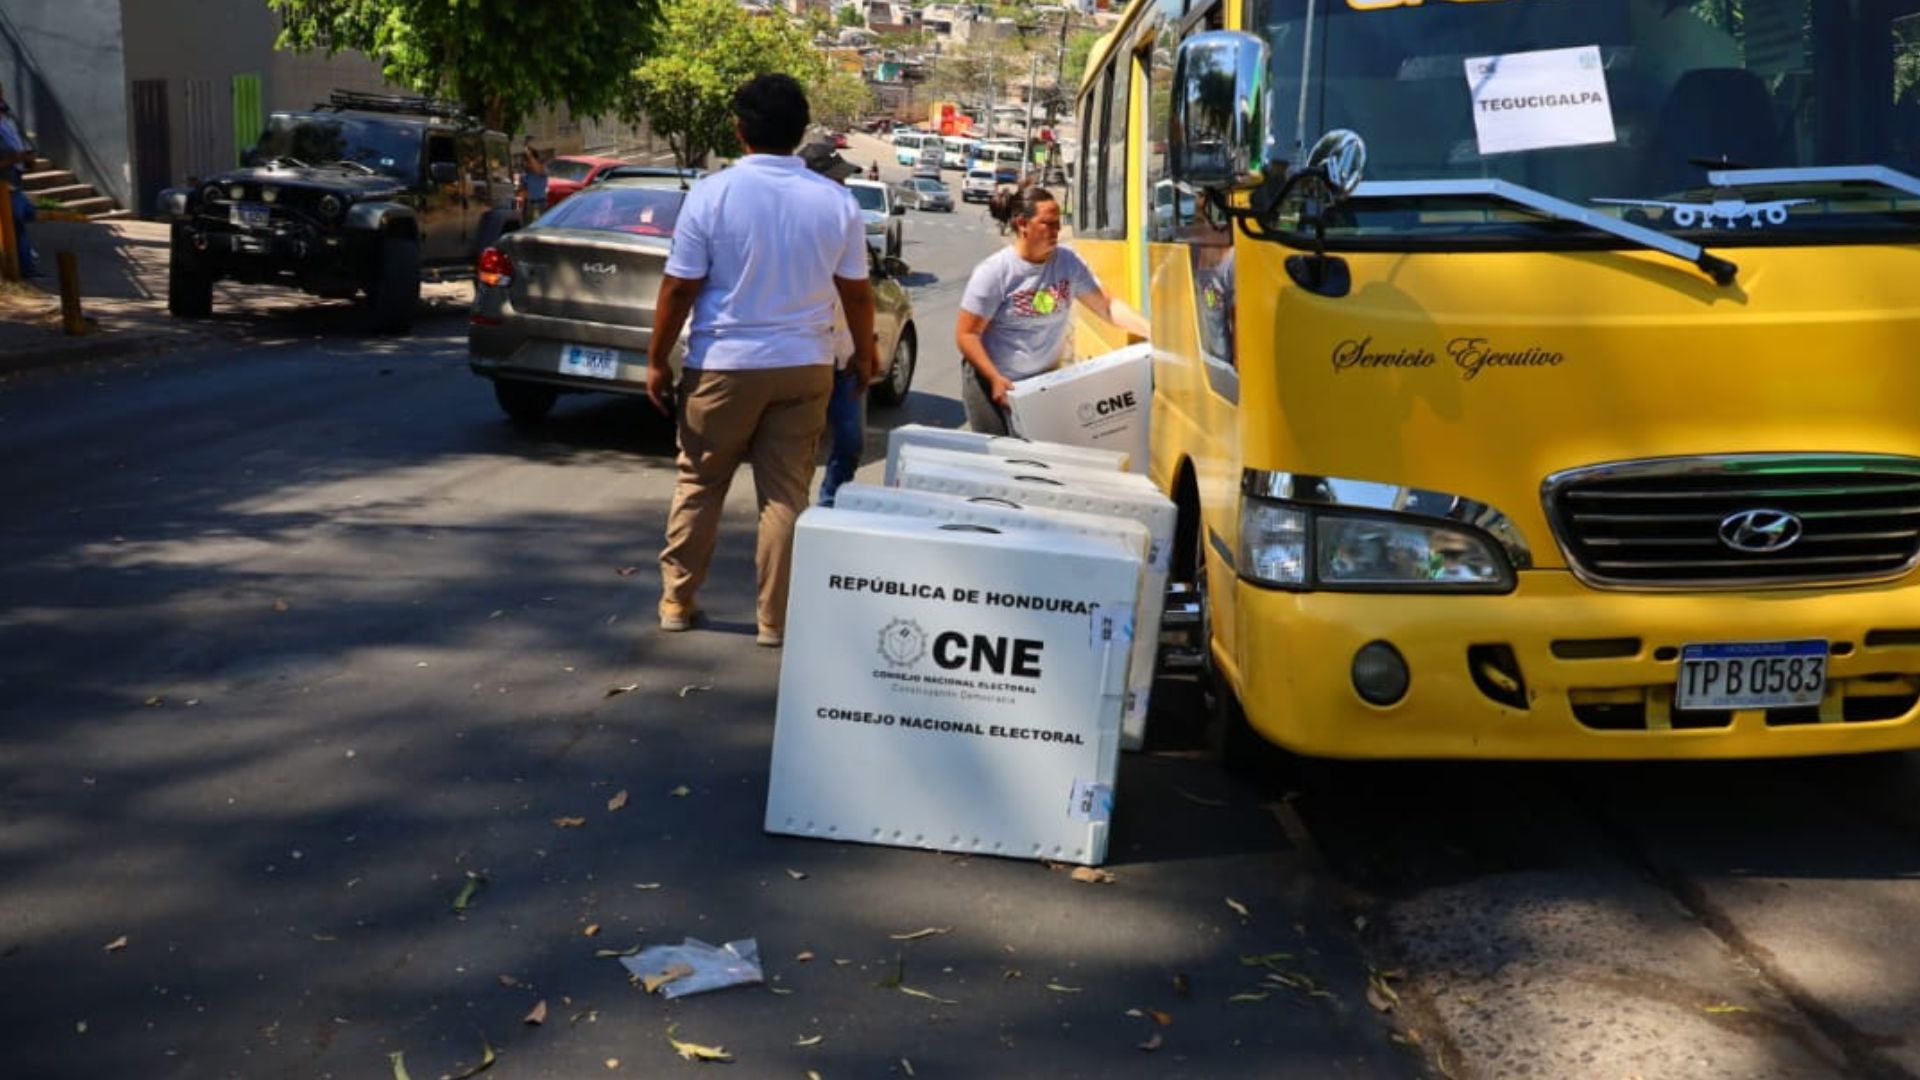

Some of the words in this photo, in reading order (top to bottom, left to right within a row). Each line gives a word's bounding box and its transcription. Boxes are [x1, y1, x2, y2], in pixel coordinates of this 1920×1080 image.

[1479, 92, 1603, 112] TEGUCIGALPA
[1332, 336, 1436, 374] Servicio
[1446, 337, 1564, 381] Ejecutivo
[1096, 391, 1136, 415] CNE
[829, 574, 946, 601] REPÚBLICA
[952, 588, 980, 604] DE
[932, 630, 1044, 678] CNE
[872, 670, 921, 683] CONSEJO
[923, 674, 975, 689] NACIONAL
[978, 680, 1037, 695] ELECTORAL
[1750, 657, 1824, 694] 0583
[816, 706, 895, 726] CONSEJO
[899, 716, 985, 736] NACIONAL
[988, 724, 1084, 746] ELECTORAL
